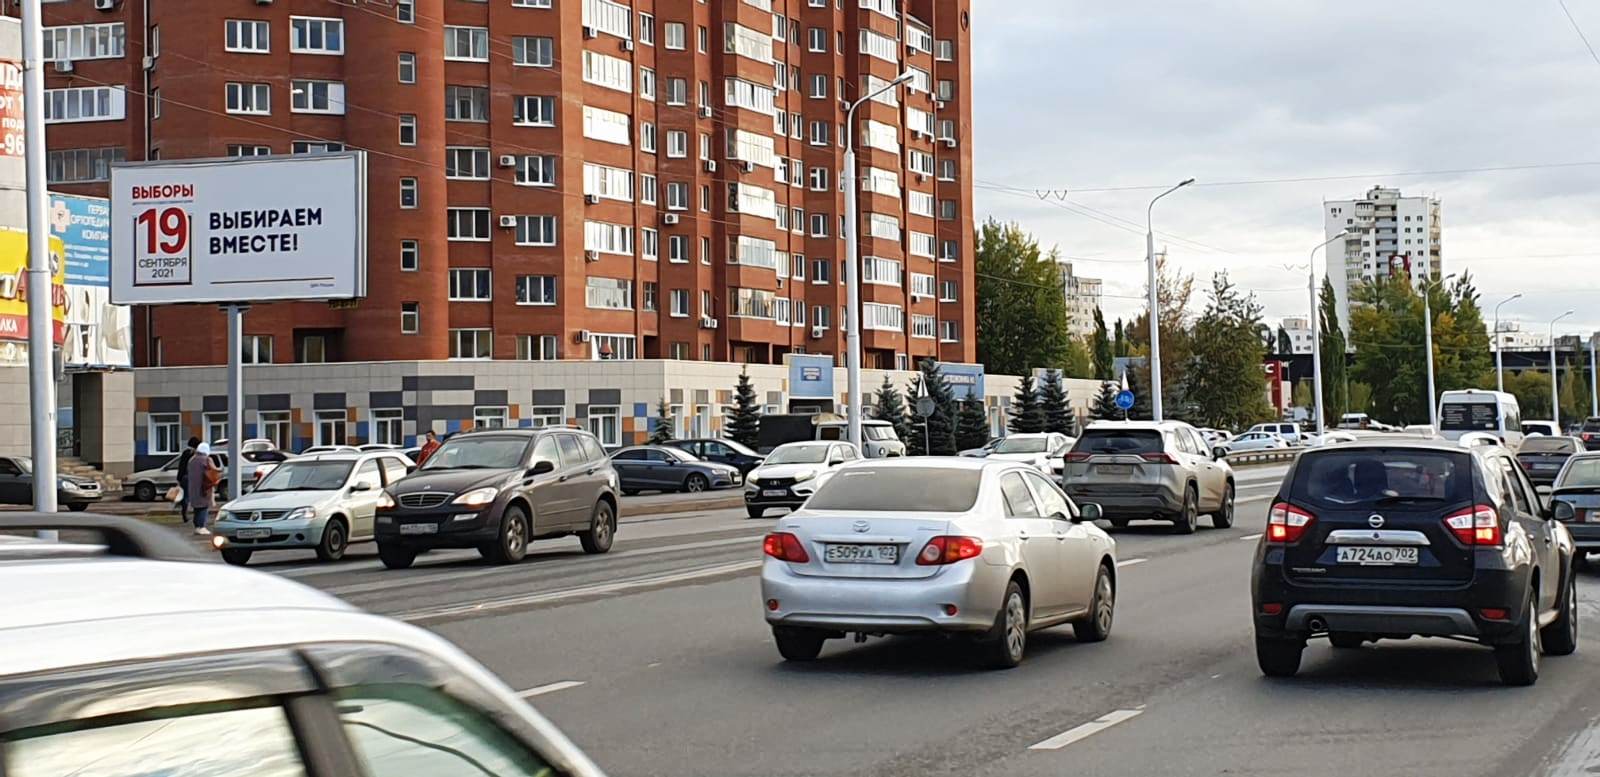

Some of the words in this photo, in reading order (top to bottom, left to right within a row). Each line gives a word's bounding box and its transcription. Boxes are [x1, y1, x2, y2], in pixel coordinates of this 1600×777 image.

[132, 184, 194, 199] ВЫБОРЫ
[209, 207, 322, 230] ВЫБИРАЕМ
[138, 207, 188, 254] 19
[209, 233, 298, 255] ВМЕСТЕ!
[138, 257, 188, 268] СЕНТЯБРЯ
[151, 268, 175, 278] 2021
